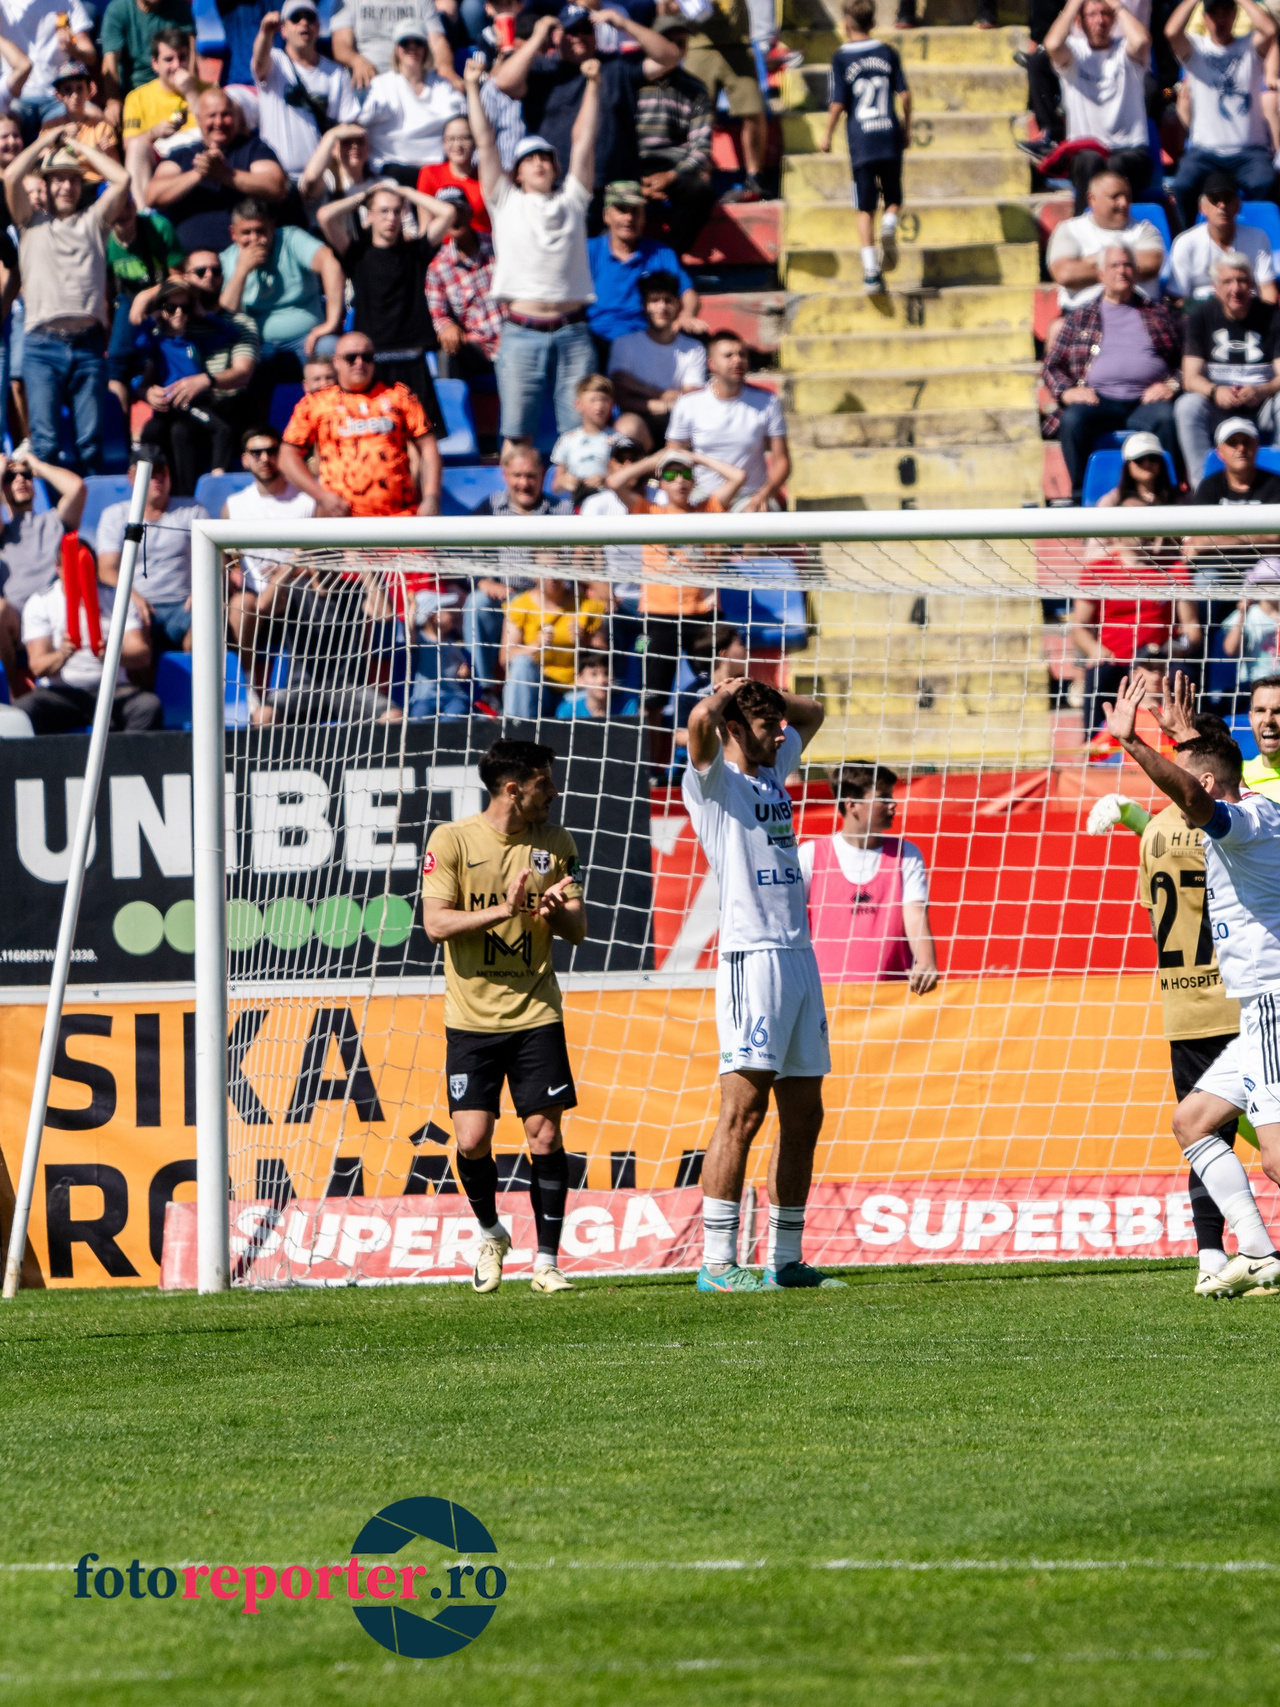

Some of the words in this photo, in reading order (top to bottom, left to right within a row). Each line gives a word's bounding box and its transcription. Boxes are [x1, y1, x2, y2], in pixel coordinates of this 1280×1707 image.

[905, 379, 927, 410] 7
[1171, 831, 1203, 847] HIL
[1151, 870, 1214, 969] 27
[751, 1015, 769, 1048] 6
[229, 1196, 676, 1269] SUPERLGA
[855, 1183, 1256, 1251] SUPERBE
